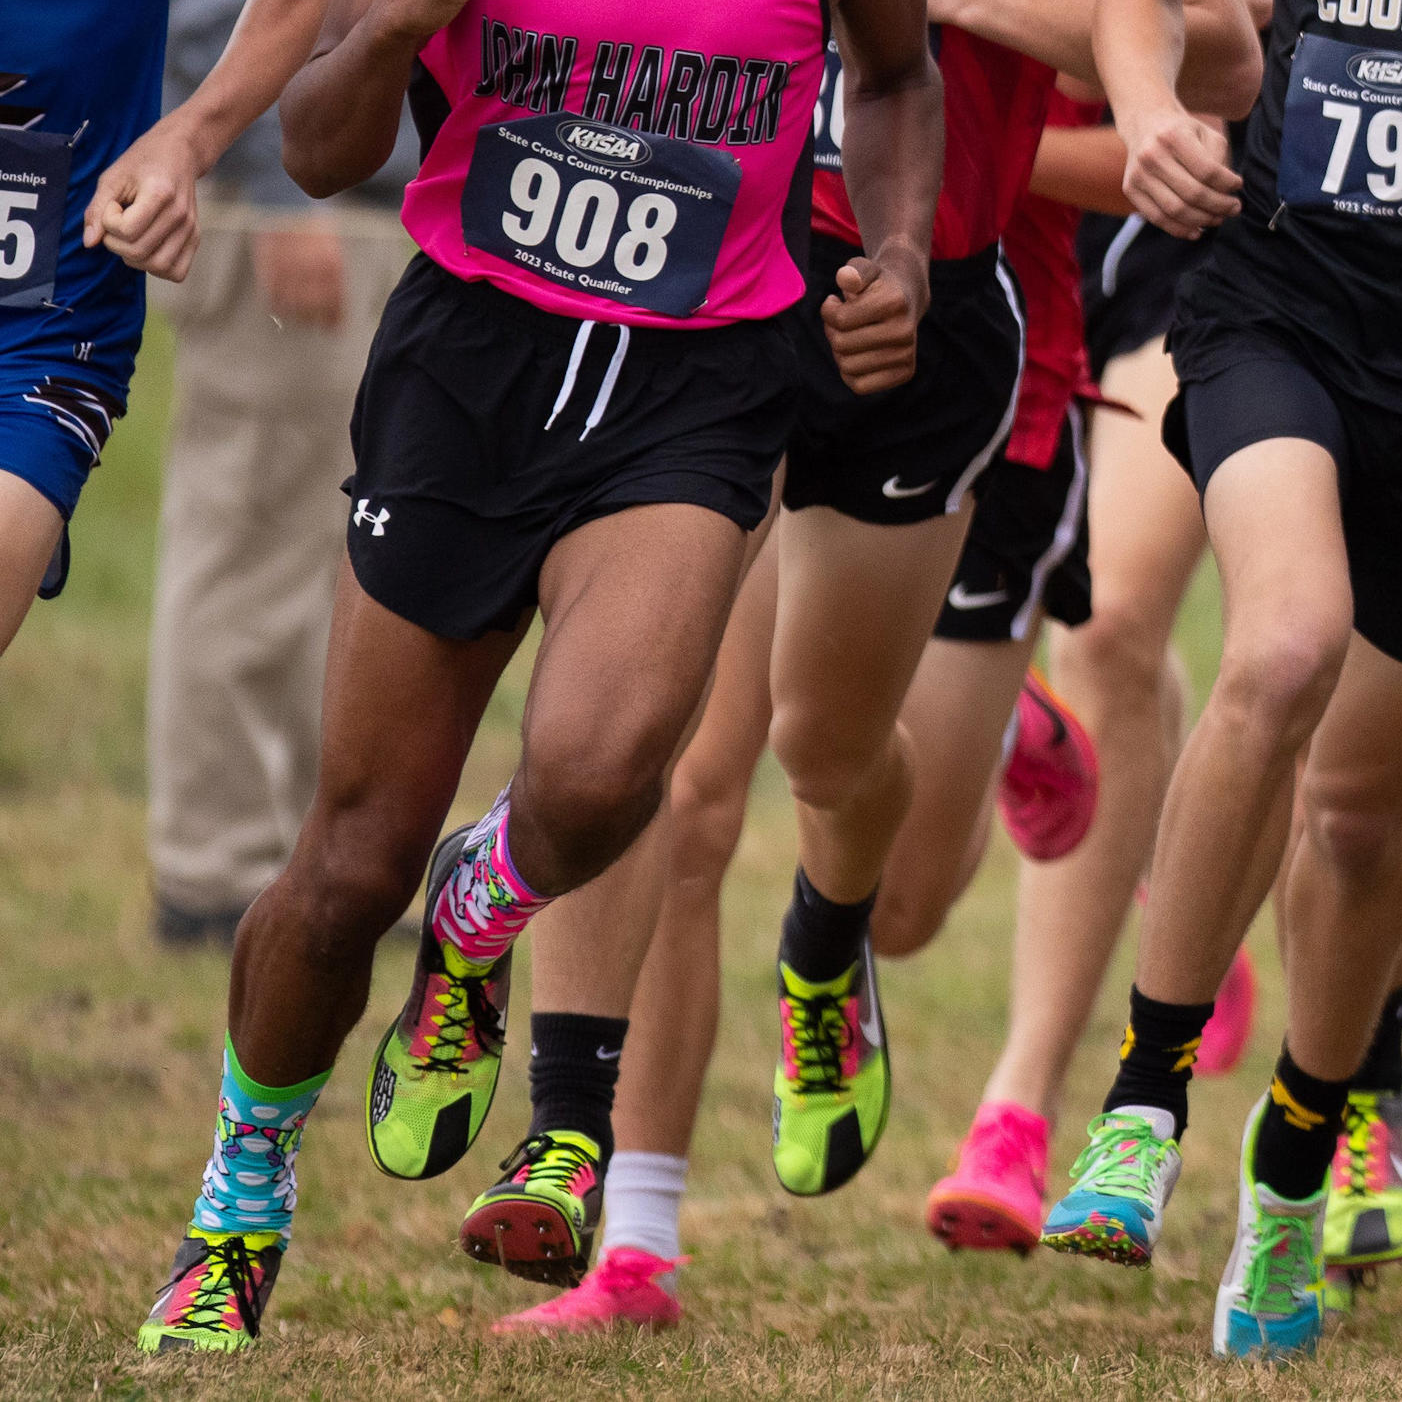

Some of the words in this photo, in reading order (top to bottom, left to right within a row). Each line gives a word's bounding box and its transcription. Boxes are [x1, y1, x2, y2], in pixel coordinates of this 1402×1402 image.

[473, 15, 577, 113] JOHN
[582, 42, 798, 146] HARDIN
[1303, 77, 1328, 94] State
[1329, 84, 1358, 100] Cross
[498, 126, 529, 148] State
[531, 141, 563, 162] Cross
[566, 155, 618, 180] Country
[620, 170, 713, 200] Championships
[567, 126, 641, 161] KHSAA
[0, 169, 48, 187] ionships
[502, 157, 678, 282] 908
[1333, 200, 1360, 214] 2023
[1362, 203, 1395, 216] State
[514, 249, 542, 267] 2023
[543, 262, 576, 282] State
[577, 274, 632, 296] Qualifier
